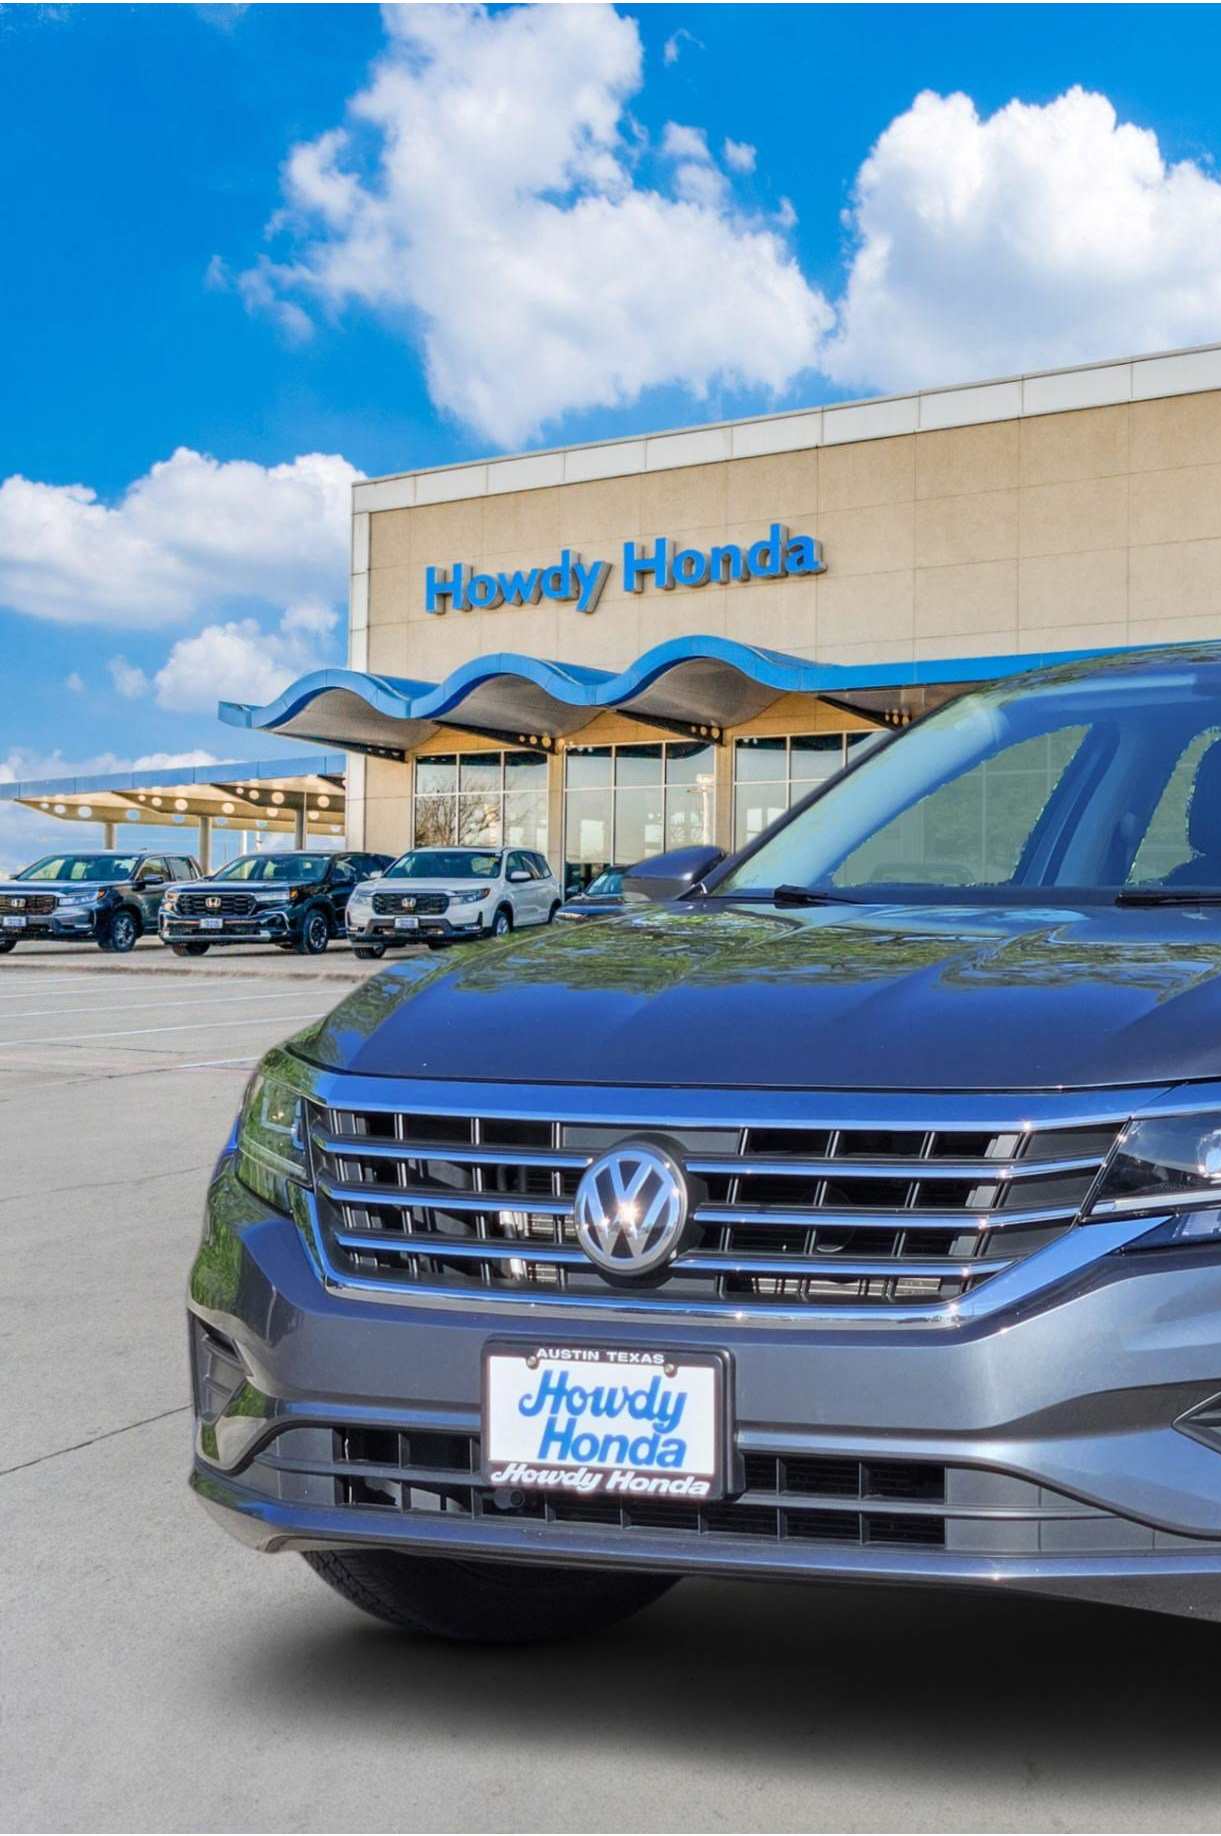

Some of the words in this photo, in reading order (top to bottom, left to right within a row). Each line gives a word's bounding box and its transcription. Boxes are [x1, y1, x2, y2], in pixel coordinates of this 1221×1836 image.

[425, 549, 611, 615] Howdy
[623, 522, 827, 594] Honda
[536, 1347, 600, 1362] AUSTIN
[606, 1350, 665, 1365] TEXAS
[518, 1369, 688, 1434] Howdy
[537, 1417, 688, 1469] Honda
[490, 1462, 604, 1492] Howdy
[605, 1470, 711, 1497] Honda
